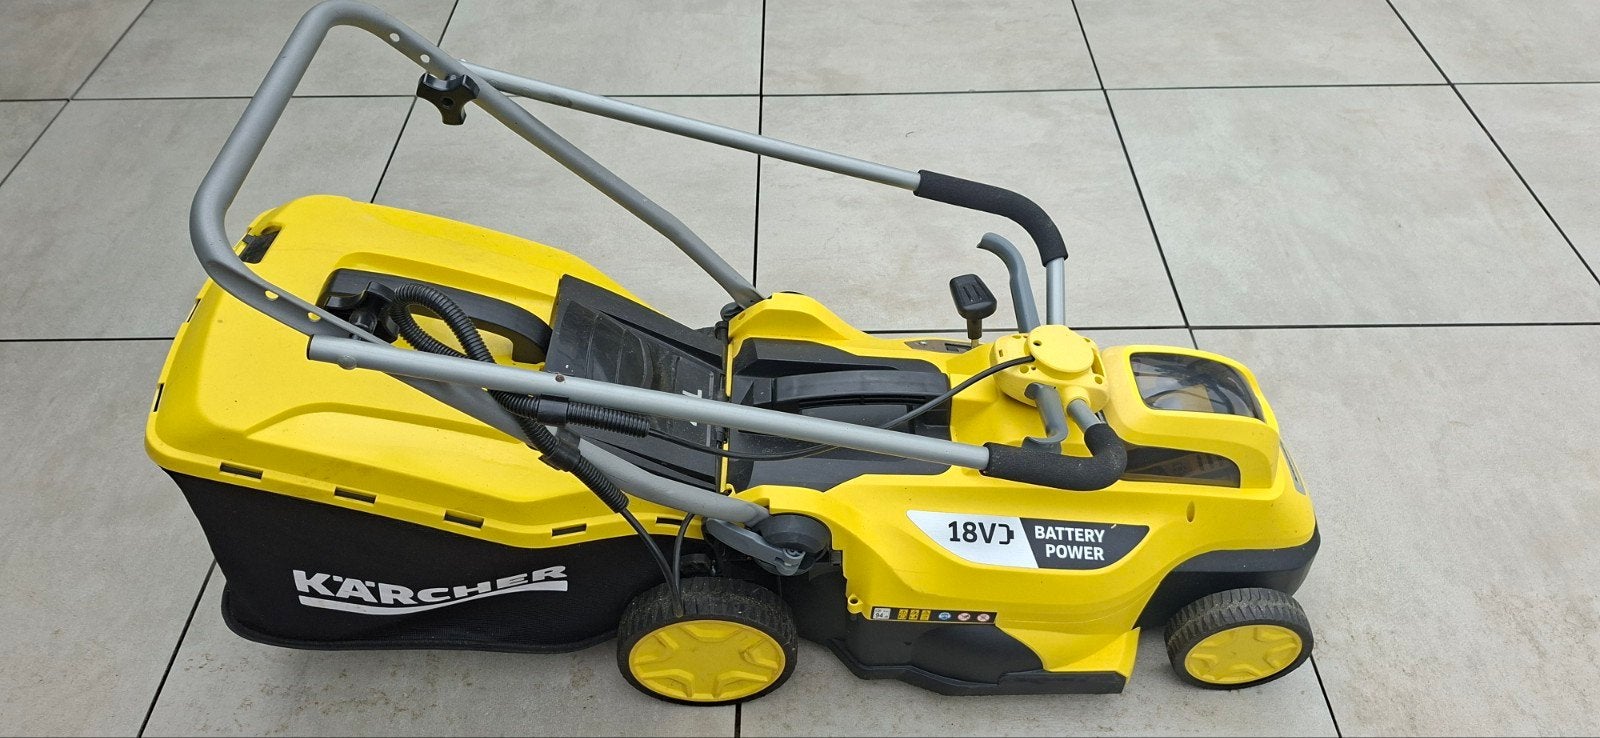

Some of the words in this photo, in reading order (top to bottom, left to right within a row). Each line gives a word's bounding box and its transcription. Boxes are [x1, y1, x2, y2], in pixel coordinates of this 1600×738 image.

[948, 521, 997, 544] 18V
[1035, 525, 1105, 543] BATTERY
[1045, 543, 1105, 561] POWER
[292, 565, 568, 605] KÄRCHER
